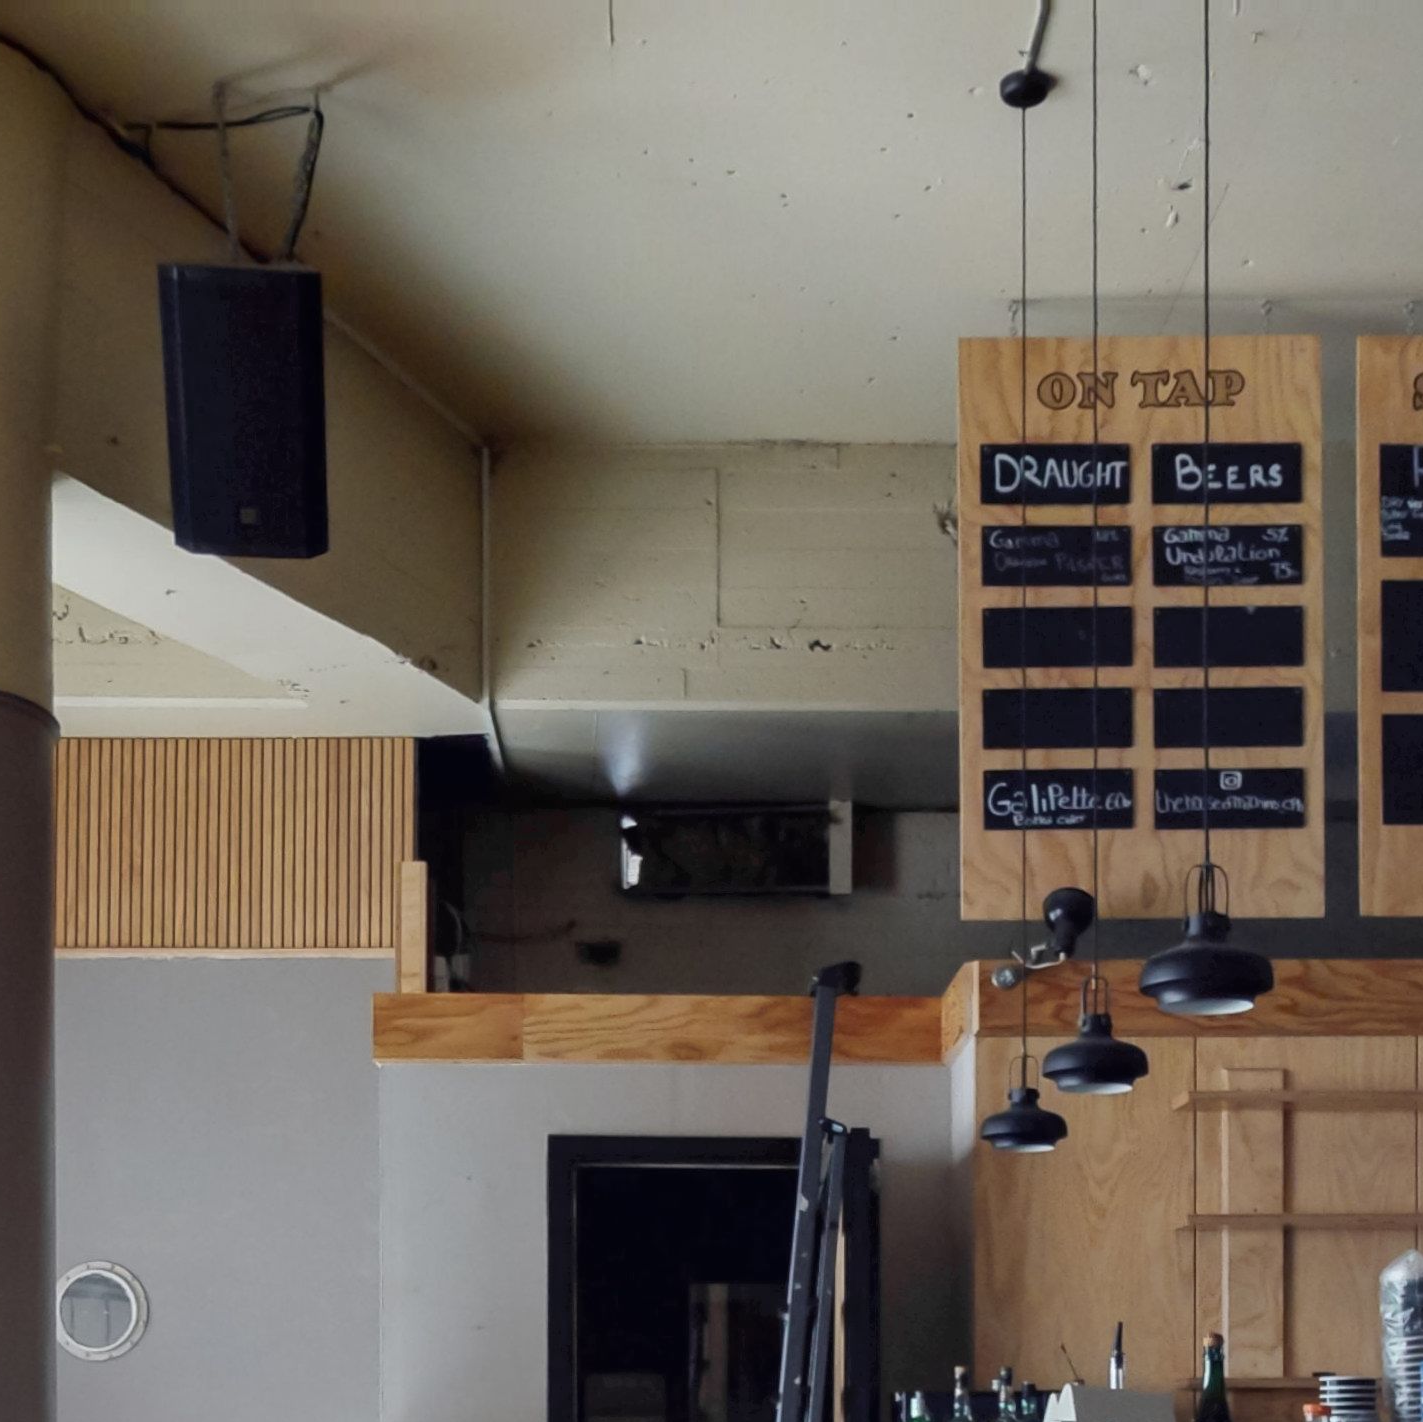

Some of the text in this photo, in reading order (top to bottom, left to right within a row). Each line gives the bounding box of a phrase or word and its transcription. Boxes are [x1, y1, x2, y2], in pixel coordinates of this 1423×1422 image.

[1037, 368, 1246, 410] ON TAP
[994, 453, 1129, 493] DRAUGHT
